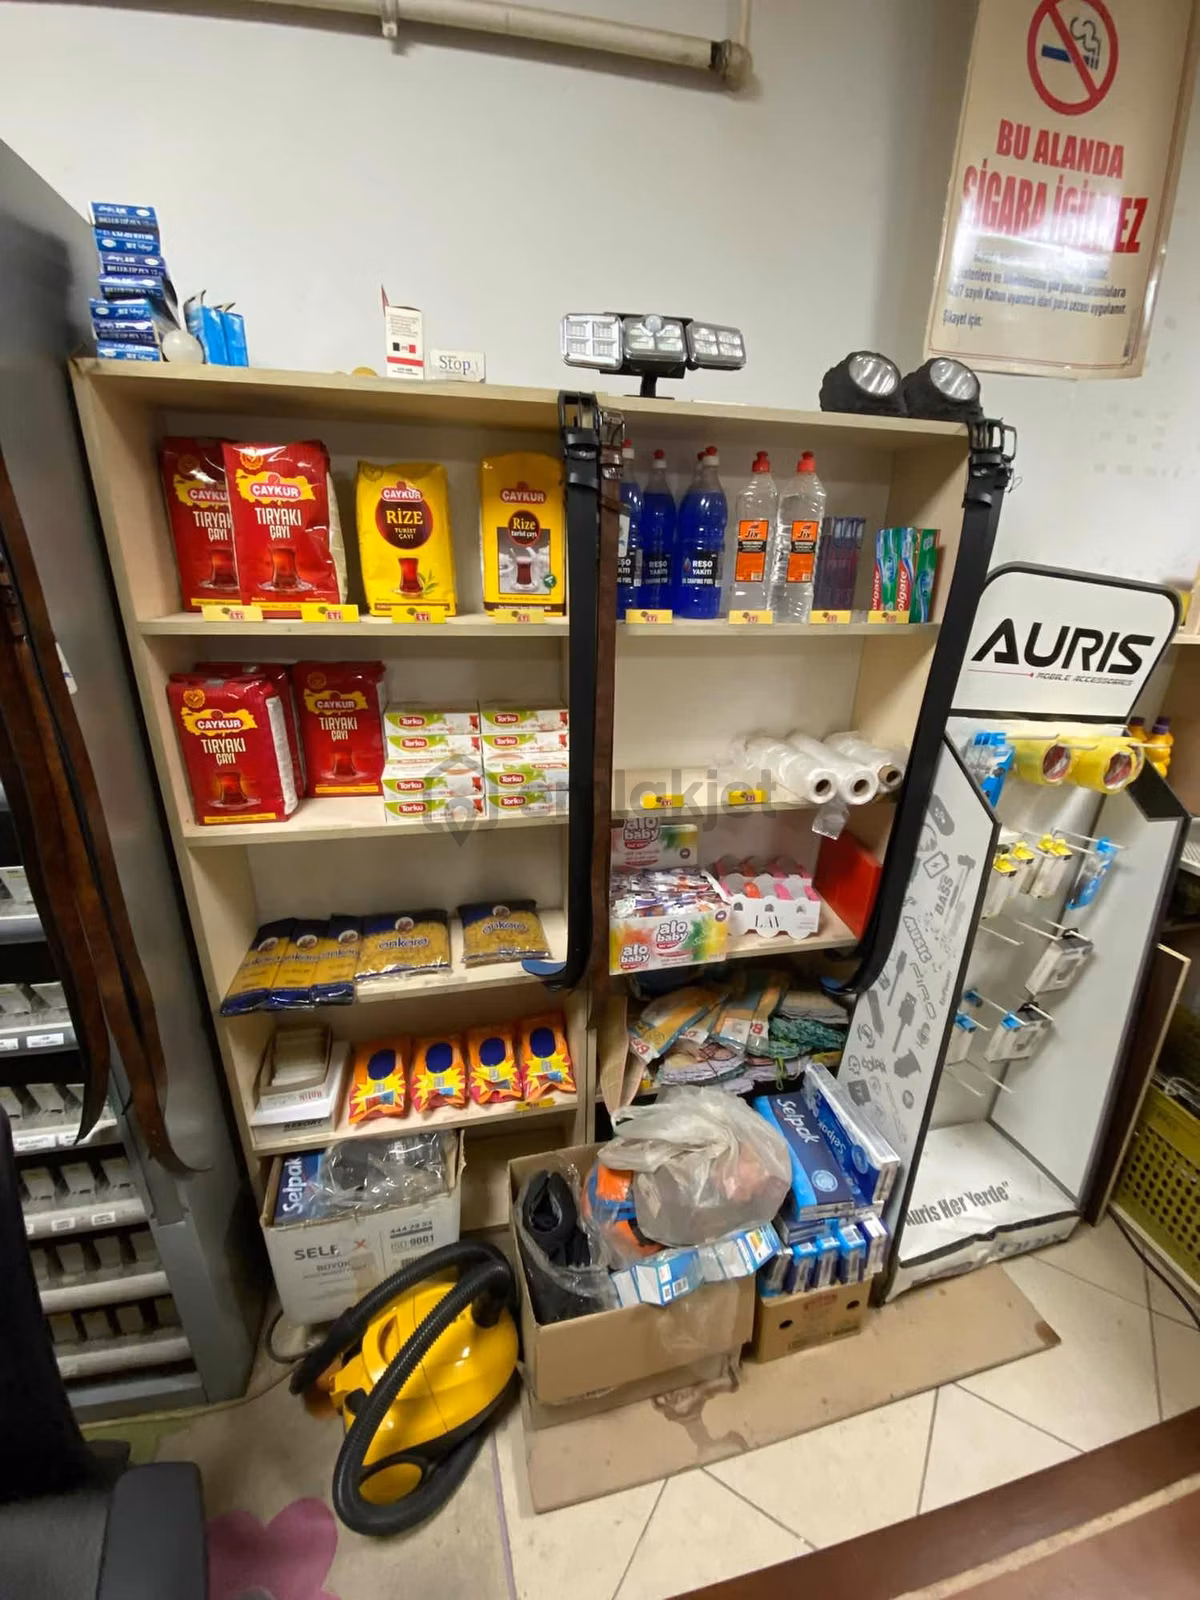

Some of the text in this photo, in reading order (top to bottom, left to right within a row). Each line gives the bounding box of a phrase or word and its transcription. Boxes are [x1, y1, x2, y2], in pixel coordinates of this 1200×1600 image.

[996, 118, 1125, 180] BU ALANDA
[963, 158, 1150, 254] SİGARA İÇİEZ
[439, 355, 471, 375] Stop
[386, 507, 424, 525] RİZE
[513, 517, 536, 531] Rize
[692, 560, 713, 568] REŞO
[872, 570, 880, 609] olgate
[897, 571, 908, 611] olgate
[971, 618, 1155, 675] AURIS
[1036, 672, 1072, 682] MOBILE
[401, 717, 423, 725] Torku
[497, 715, 517, 723] Torku
[403, 739, 425, 747] Torku
[496, 737, 517, 746] Torku
[400, 781, 423, 790] Torku
[501, 774, 522, 783] Torku
[401, 804, 424, 813] Torku
[503, 797, 524, 806] Torku
[624, 828, 660, 842] baby
[935, 876, 954, 916] BASS
[660, 920, 688, 935] alo
[656, 931, 689, 943] baby
[903, 916, 932, 964] MUSIC
[623, 943, 649, 956] alo
[621, 954, 651, 963] baby
[777, 1098, 820, 1143] Selpak
[283, 1157, 306, 1215] Selpak
[938, 1196, 968, 1219] Her
